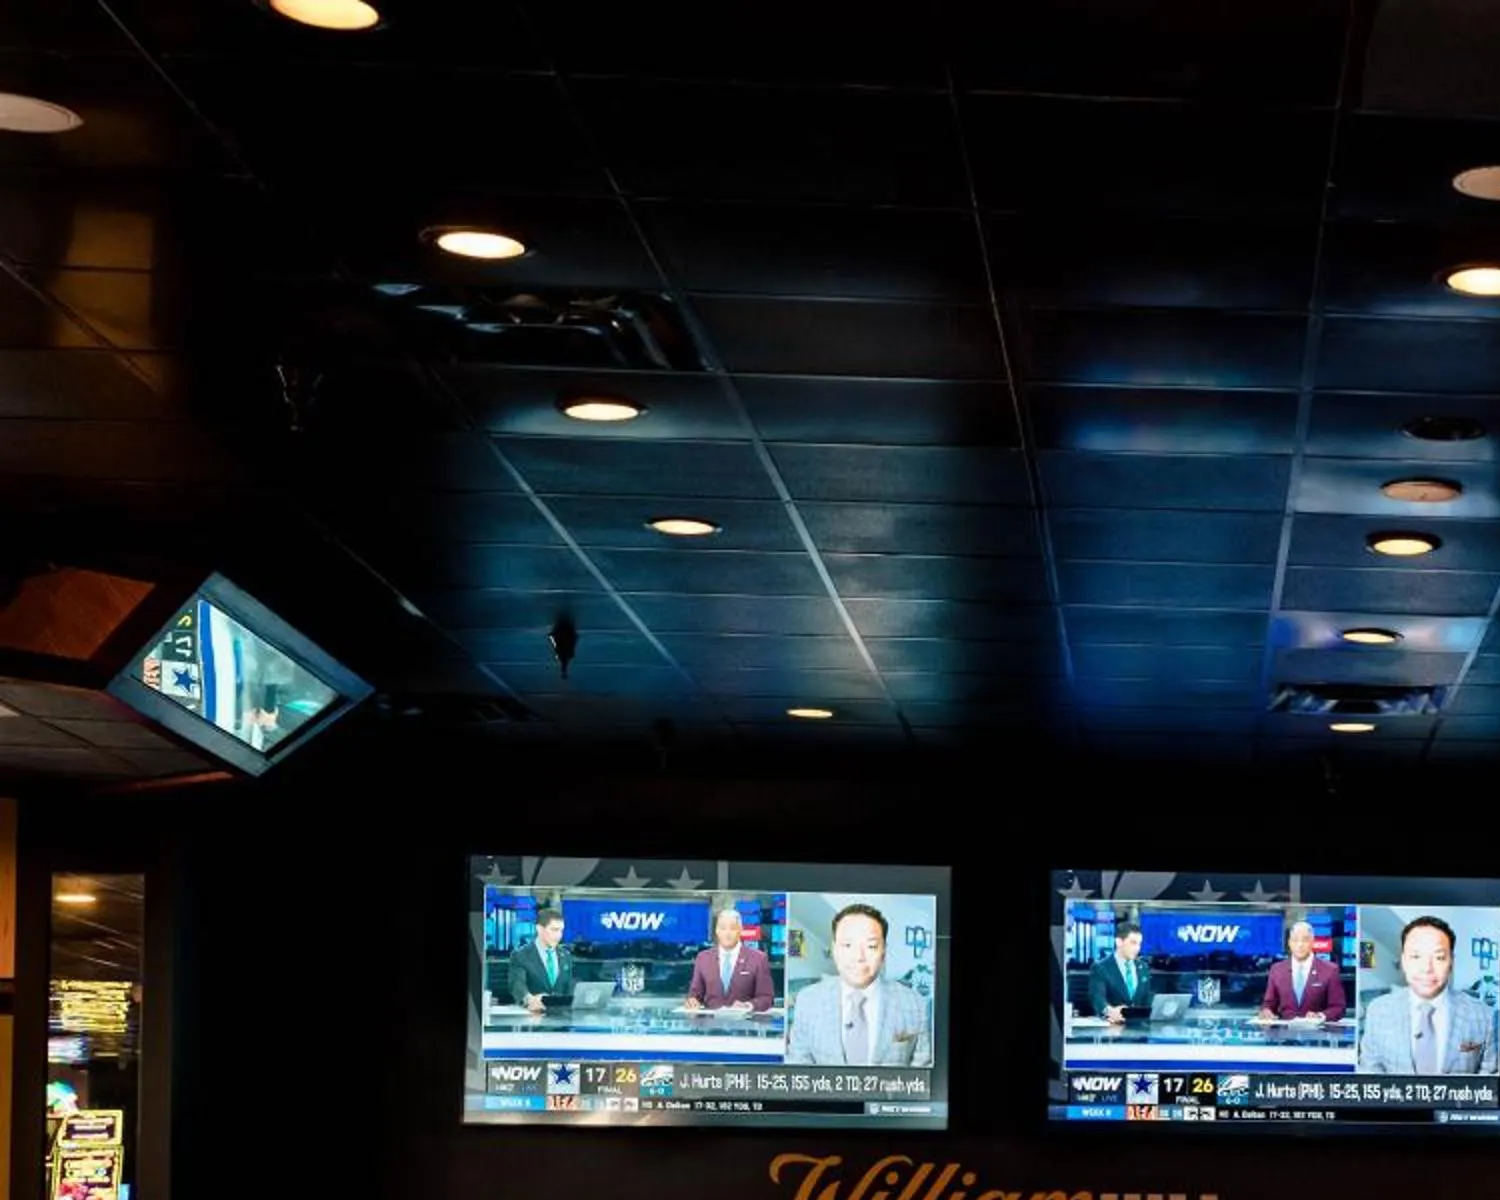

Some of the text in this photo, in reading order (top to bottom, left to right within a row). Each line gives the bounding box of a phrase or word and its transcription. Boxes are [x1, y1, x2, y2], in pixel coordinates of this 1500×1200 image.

[608, 912, 664, 930] NOW
[1184, 925, 1240, 943] NOW
[497, 1066, 541, 1080] NOW
[585, 1067, 638, 1083] 17 26
[692, 1073, 722, 1089] Hurts
[757, 1075, 788, 1091] 15-25,
[791, 1075, 810, 1090] 155
[835, 1076, 842, 1090] 2
[864, 1076, 878, 1091] 27
[1078, 1077, 1122, 1091] NOW
[1163, 1078, 1214, 1093] 17 26
[1255, 1083, 1264, 1098] J.
[1267, 1082, 1297, 1098] Hurts
[1298, 1082, 1325, 1100] (PHI):
[1329, 1083, 1361, 1101] 15-25,
[1363, 1084, 1381, 1099] 155
[1405, 1085, 1412, 1100] 2
[1433, 1085, 1447, 1100] 27
[1448, 1085, 1472, 1100] rush
